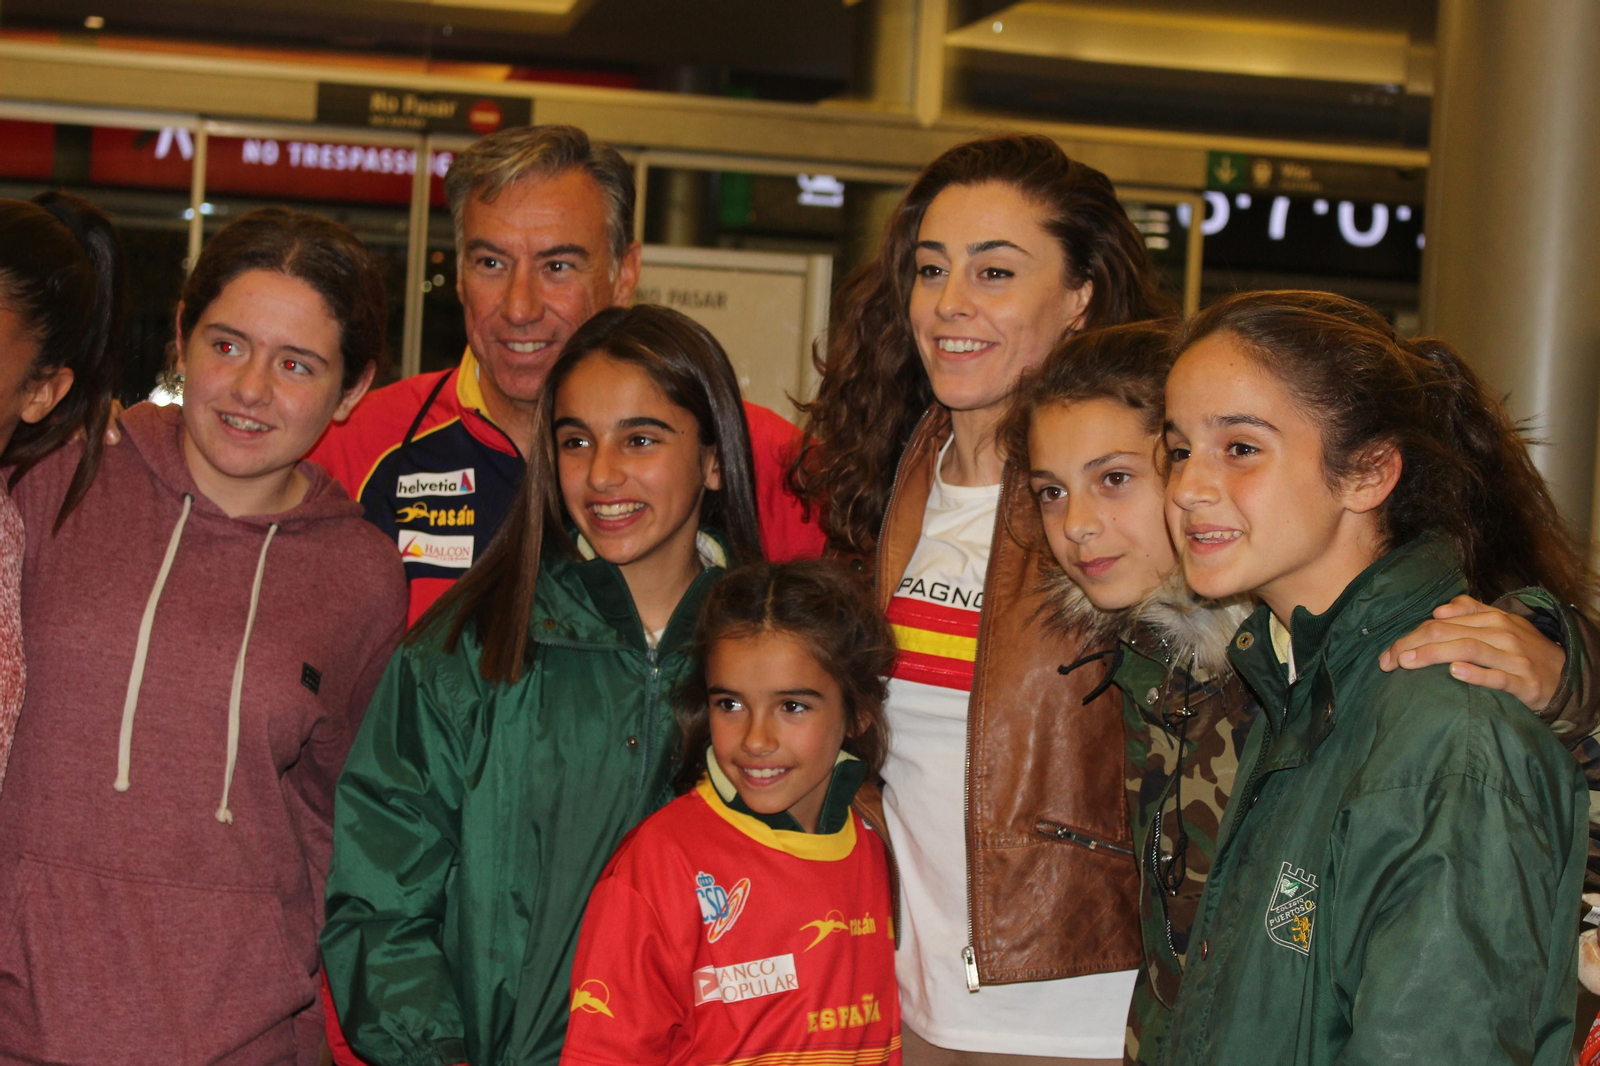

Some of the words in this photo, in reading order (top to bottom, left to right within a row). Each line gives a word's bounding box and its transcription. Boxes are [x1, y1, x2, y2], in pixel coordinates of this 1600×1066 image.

[242, 139, 280, 166] NO
[399, 479, 457, 494] helvetia
[429, 505, 475, 526] rasán
[424, 544, 470, 557] HALCON
[807, 993, 881, 1033] ESPAÑA
